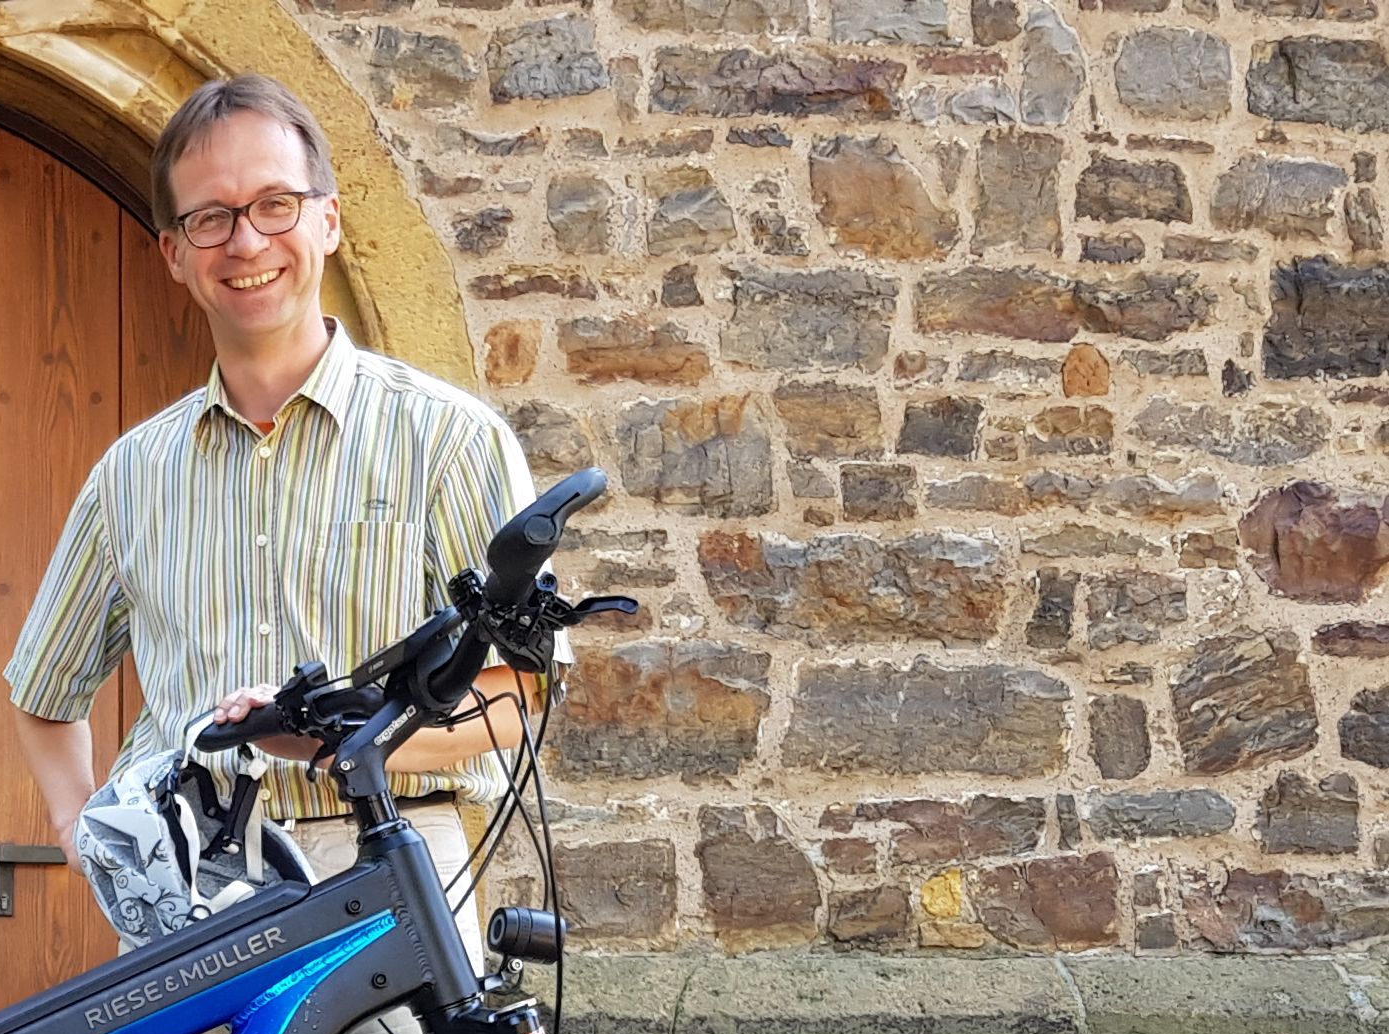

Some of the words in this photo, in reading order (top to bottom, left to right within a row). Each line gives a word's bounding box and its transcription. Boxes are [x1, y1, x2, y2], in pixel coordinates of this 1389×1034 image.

[84, 980, 163, 1029] RIESE
[164, 975, 180, 993] &
[179, 926, 286, 987] MÜLLER
